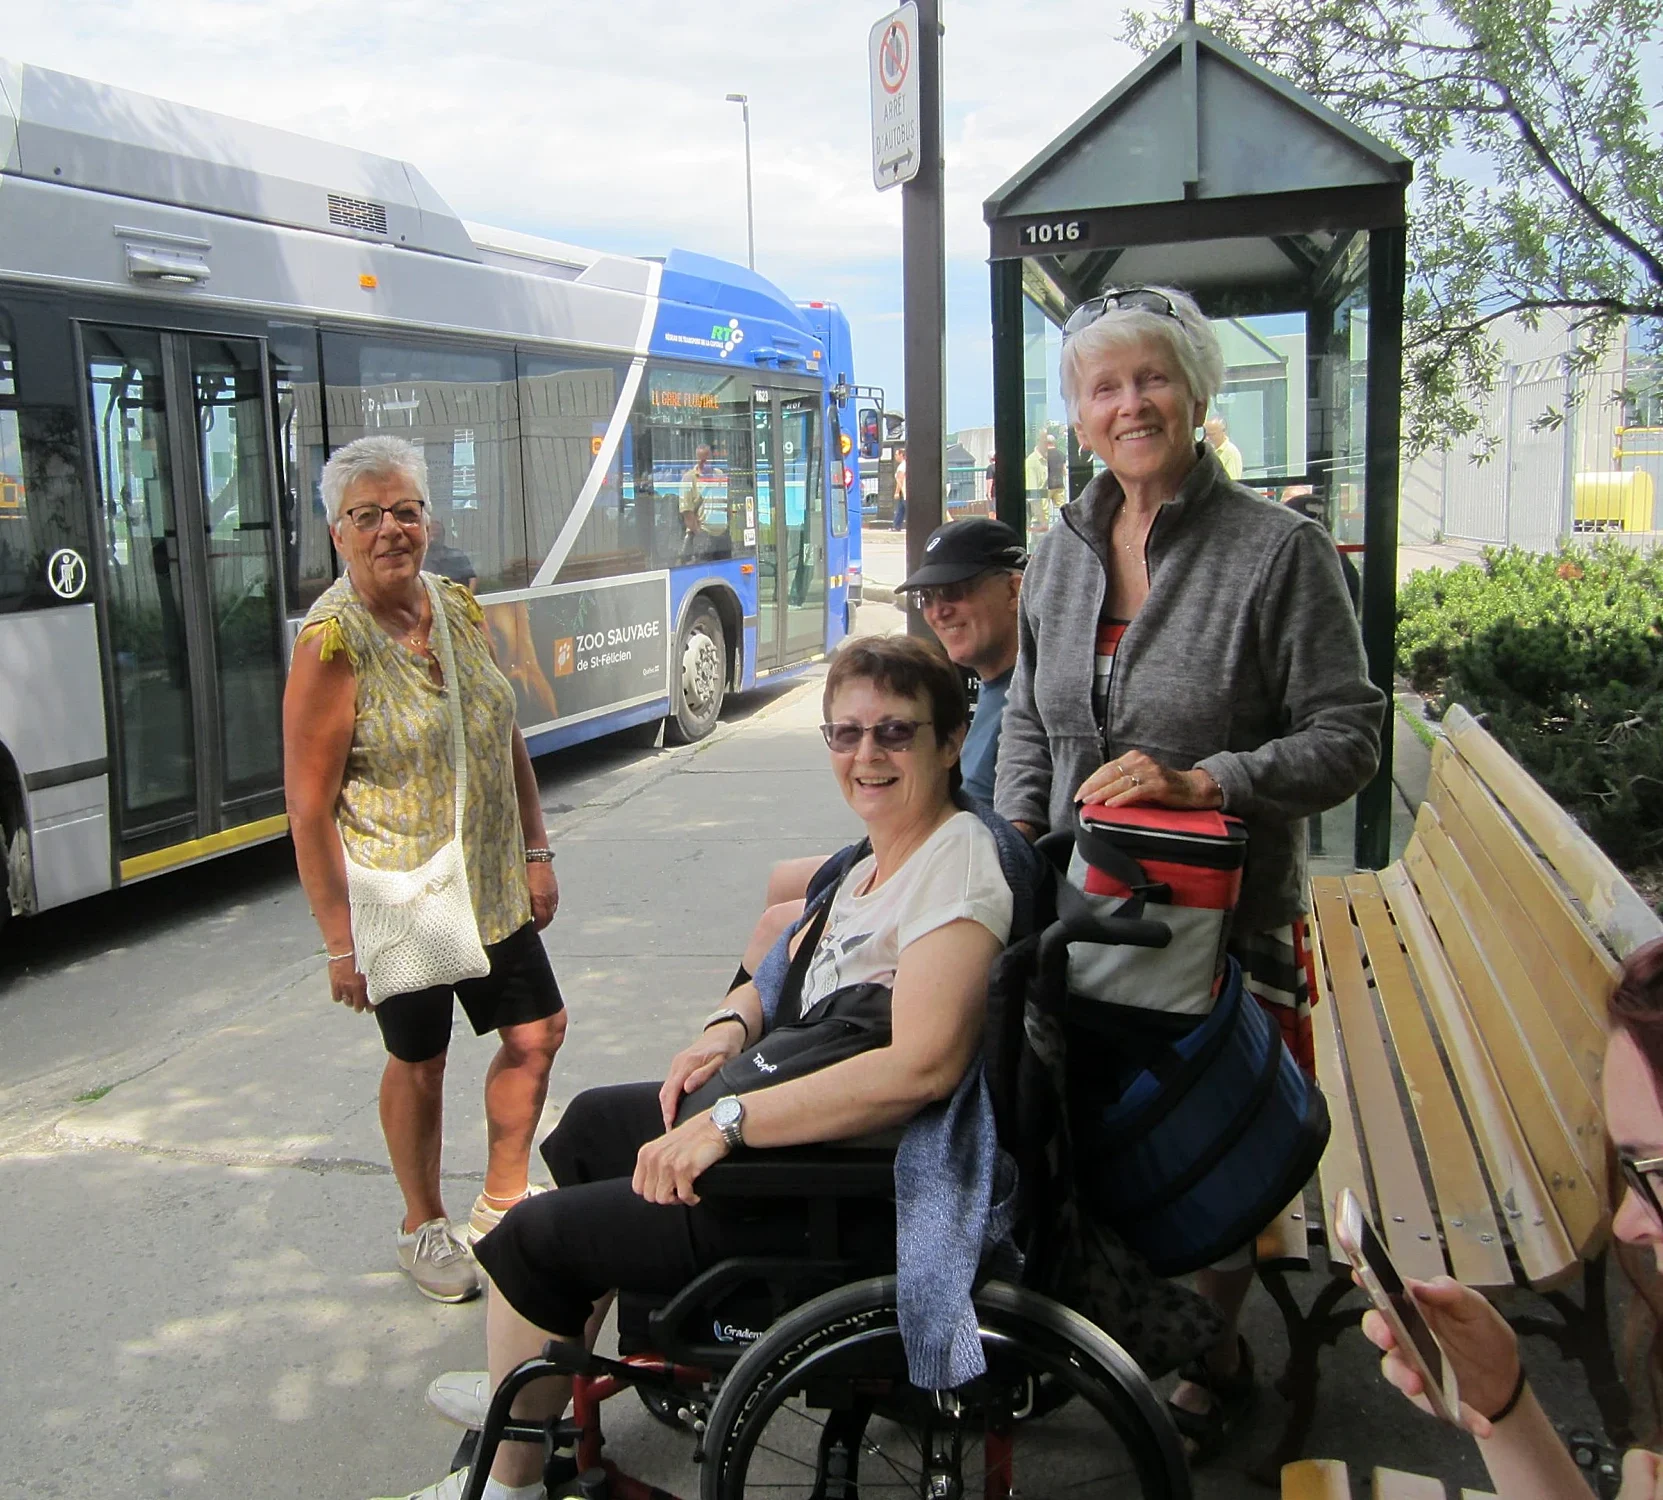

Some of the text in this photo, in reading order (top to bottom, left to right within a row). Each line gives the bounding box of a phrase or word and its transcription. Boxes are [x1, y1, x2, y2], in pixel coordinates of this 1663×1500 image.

[884, 93, 906, 123] ARRÊT
[876, 119, 915, 155] D'AUTOBUS
[1026, 221, 1080, 243] 1016
[711, 325, 744, 344] RTC
[576, 620, 660, 652] ZOO SAUVAGE
[577, 650, 632, 671] de St-Félicien
